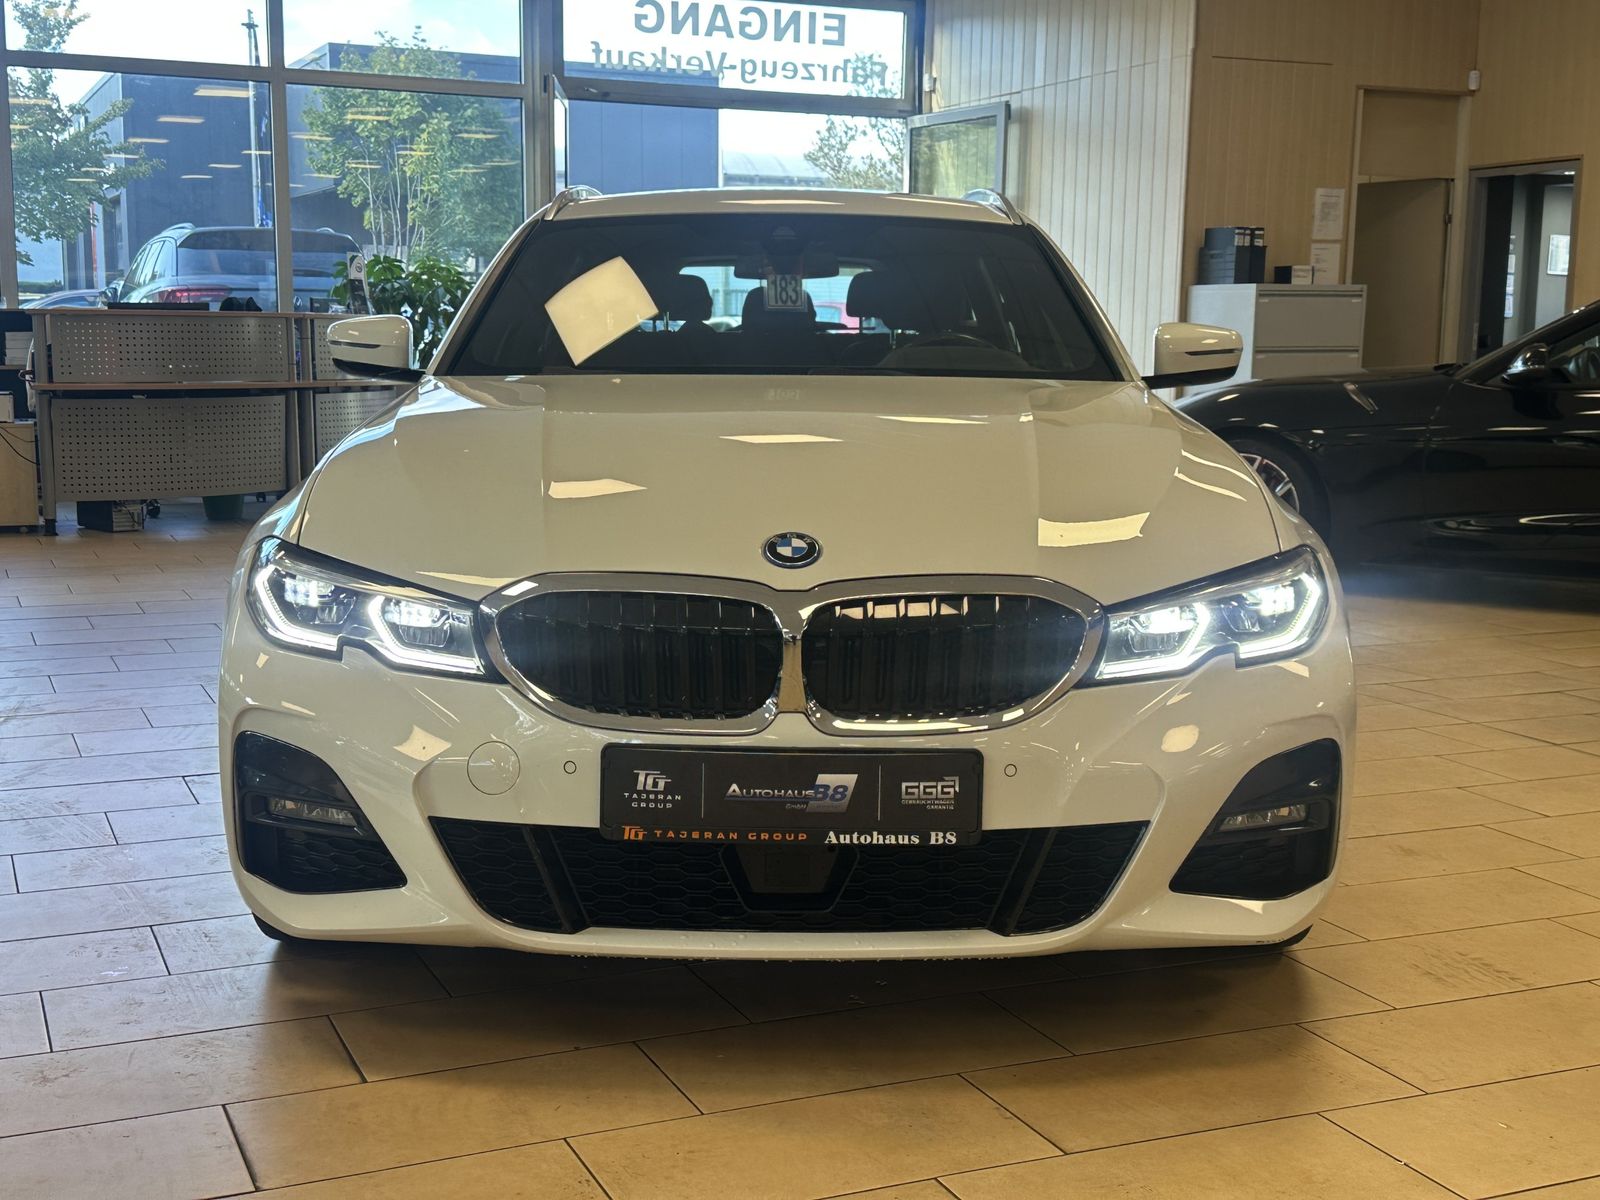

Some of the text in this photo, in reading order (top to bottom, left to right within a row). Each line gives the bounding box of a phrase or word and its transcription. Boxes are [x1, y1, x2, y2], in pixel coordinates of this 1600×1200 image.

[813, 784, 849, 802] B8
[901, 781, 955, 799] GGG
[624, 792, 682, 801] TAJERAN
[632, 801, 673, 809] GROUP
[654, 830, 738, 840] TAJERAN
[748, 832, 807, 841] GROUP
[825, 831, 957, 845] Autohaus B8
